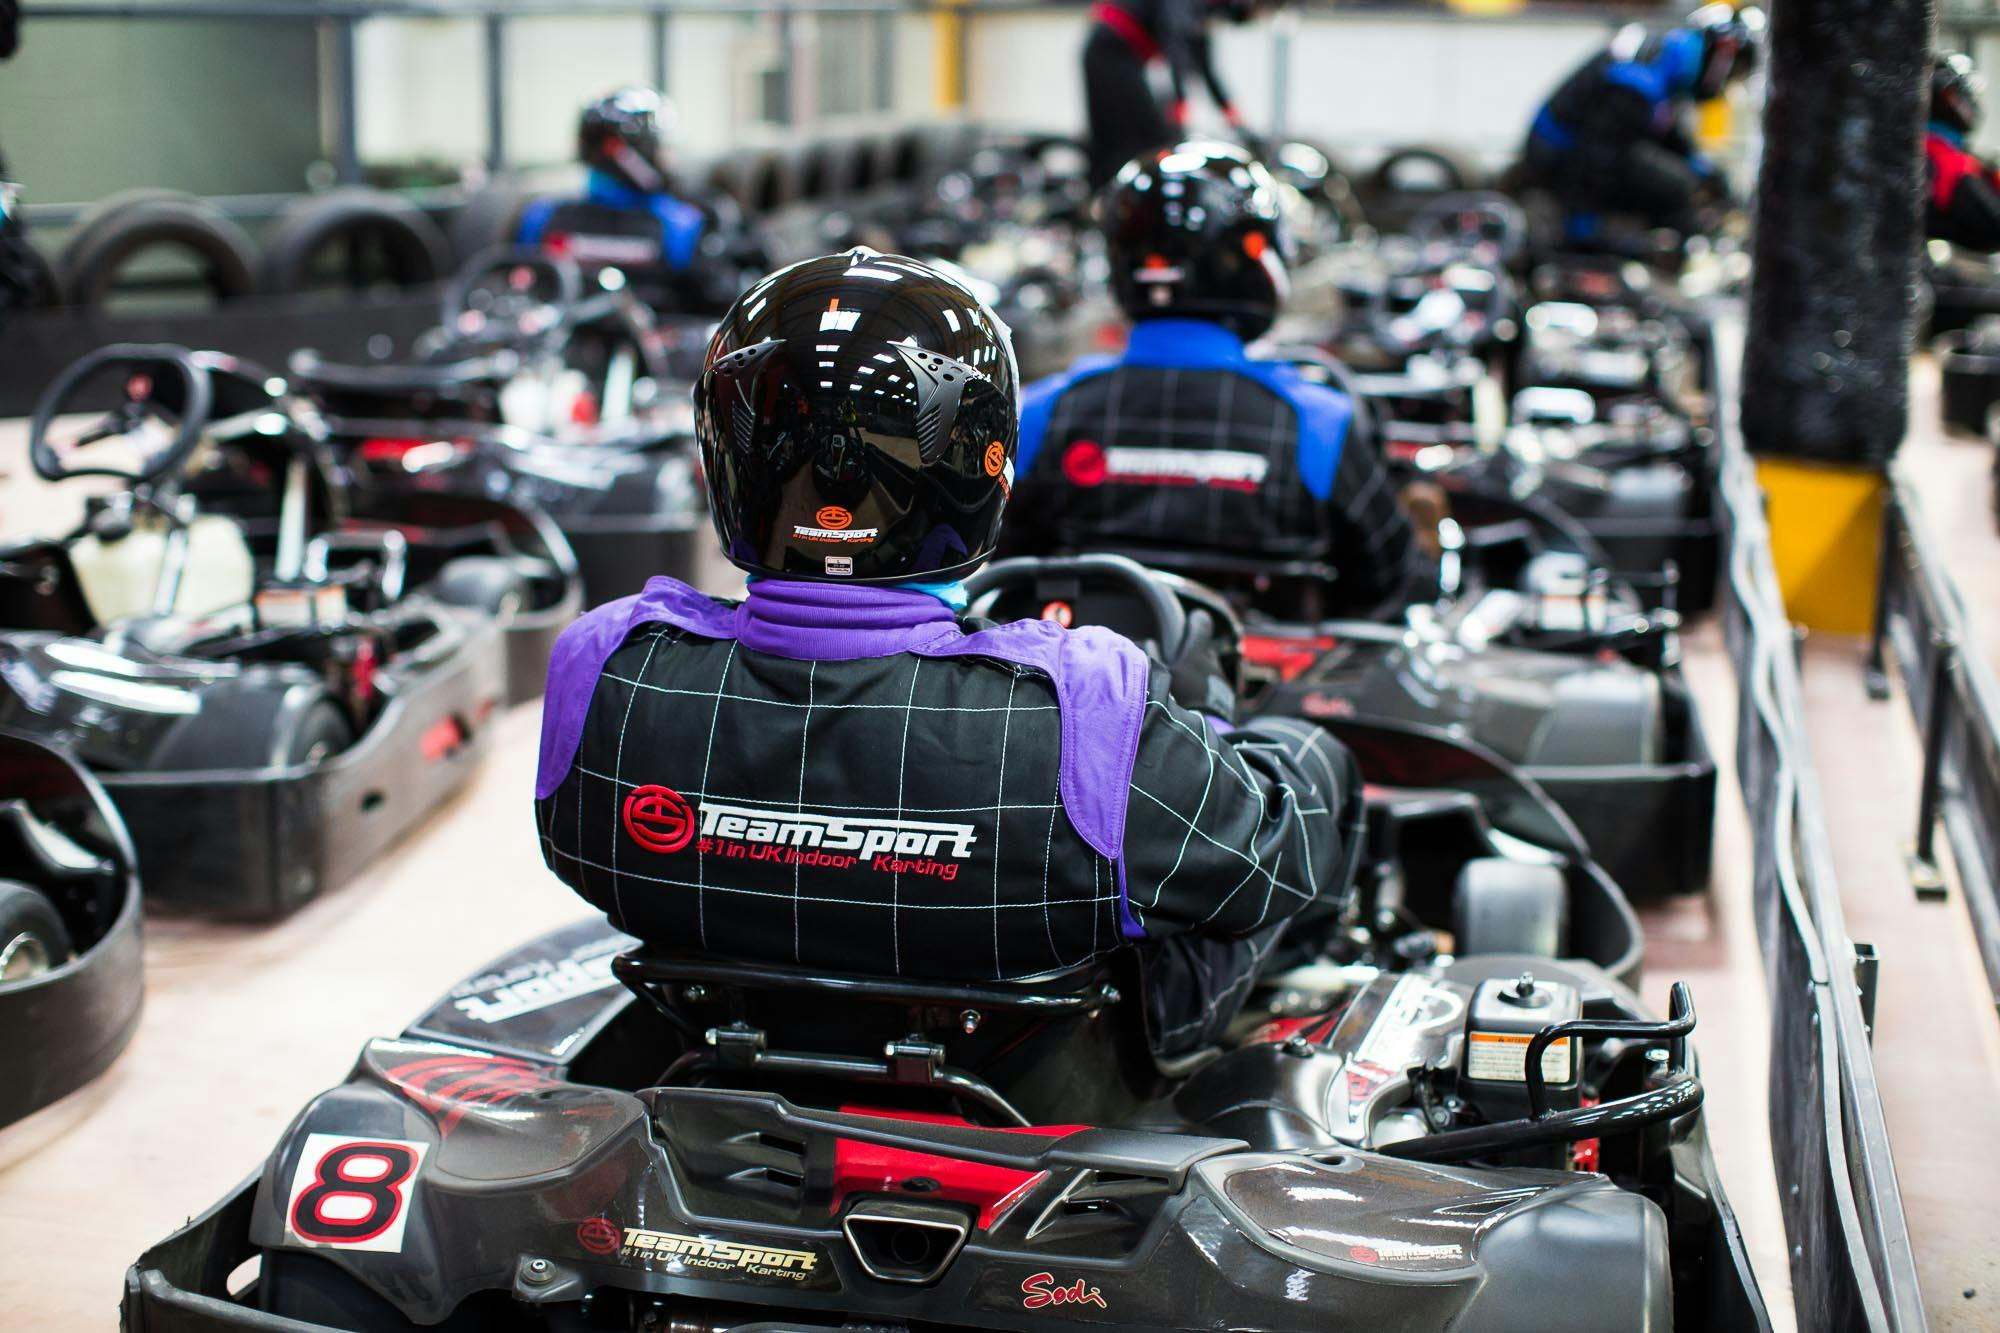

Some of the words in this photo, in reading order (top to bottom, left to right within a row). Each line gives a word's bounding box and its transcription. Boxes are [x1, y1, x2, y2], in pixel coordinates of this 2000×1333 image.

[794, 526, 879, 541] TeamSport
[698, 802, 978, 860] TeamSport
[748, 844, 784, 863] UK
[784, 848, 857, 870] Indoor
[873, 854, 960, 880] Karting
[291, 1141, 419, 1244] 8
[624, 1227, 818, 1270] TeamSport
[655, 1251, 683, 1264] UK
[683, 1255, 736, 1271] Indoor
[746, 1264, 807, 1281] Karting
[1022, 1272, 1107, 1309] Sodi
